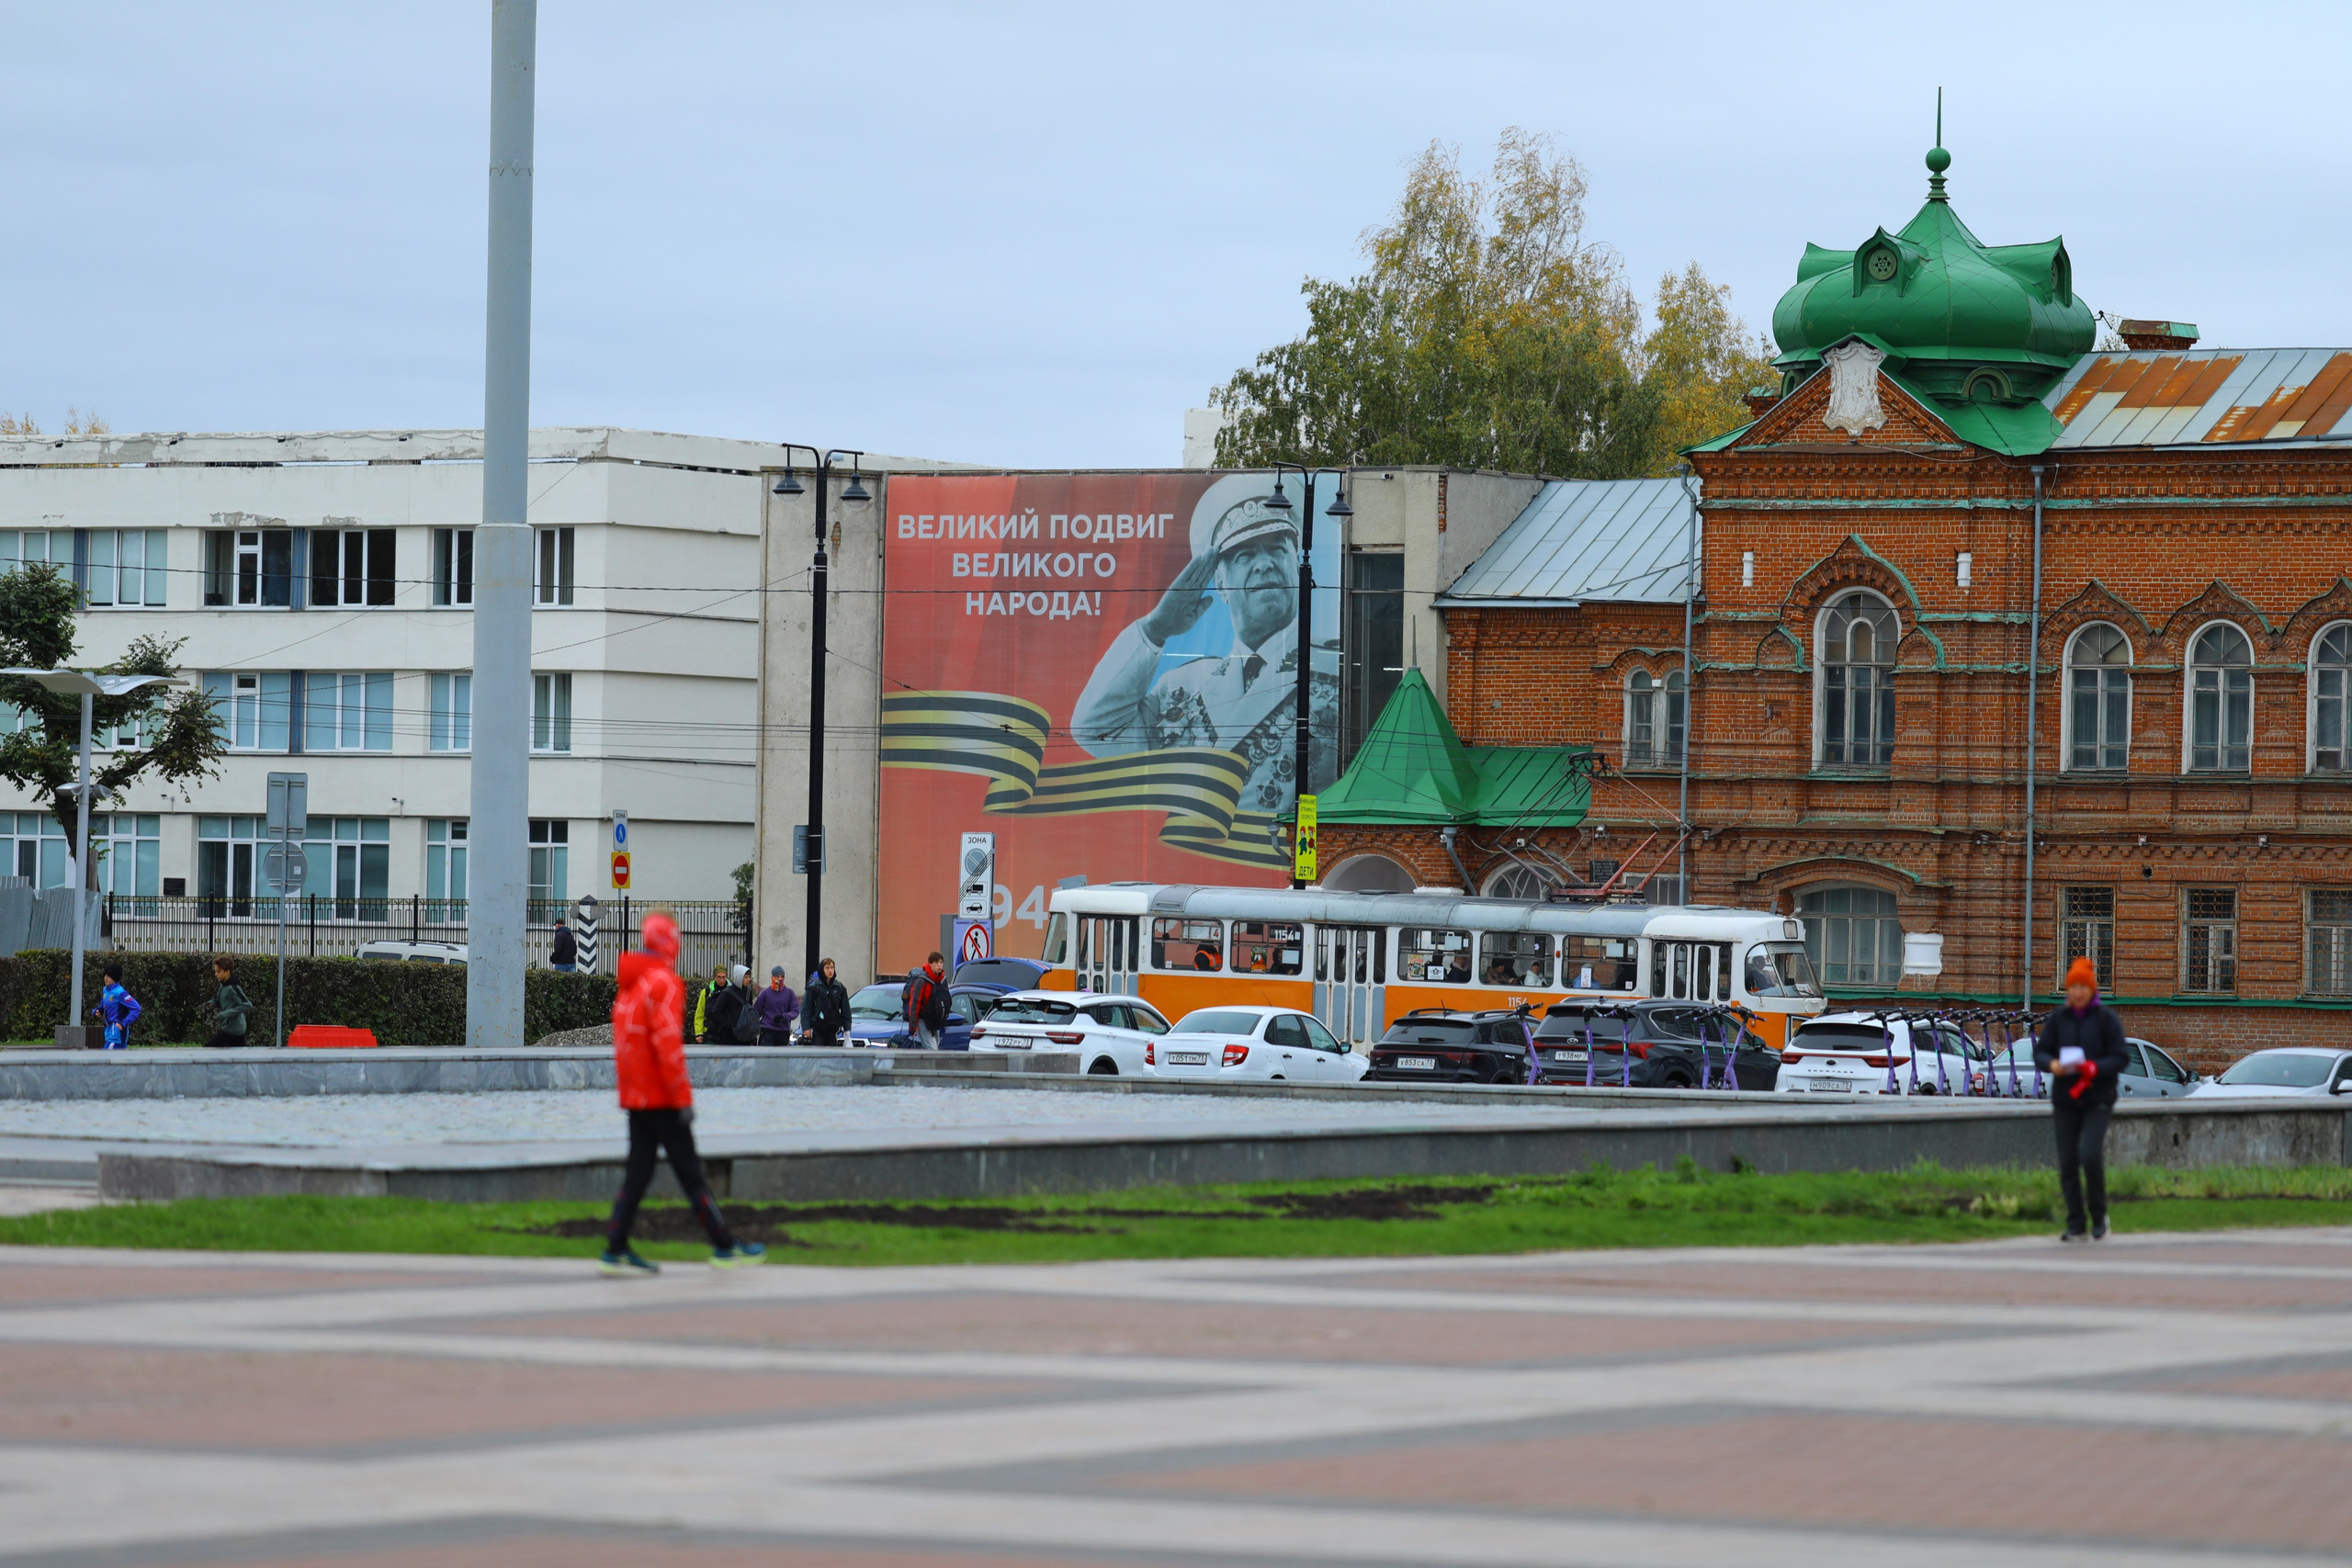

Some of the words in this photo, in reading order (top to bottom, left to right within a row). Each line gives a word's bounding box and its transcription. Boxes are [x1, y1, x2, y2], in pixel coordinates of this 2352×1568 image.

[898, 507, 1039, 539] ВЕЛИКИЙ
[1049, 513, 1173, 544] ПОДВИГ
[953, 552, 1116, 578] ВЕЛИКОГО
[966, 591, 1102, 620] НАРОДА!
[967, 836, 987, 844] ЗОНА
[1298, 866, 1314, 878] ДЕТИ
[1213, 928, 1220, 938] 4
[1274, 930, 1295, 942] 1154
